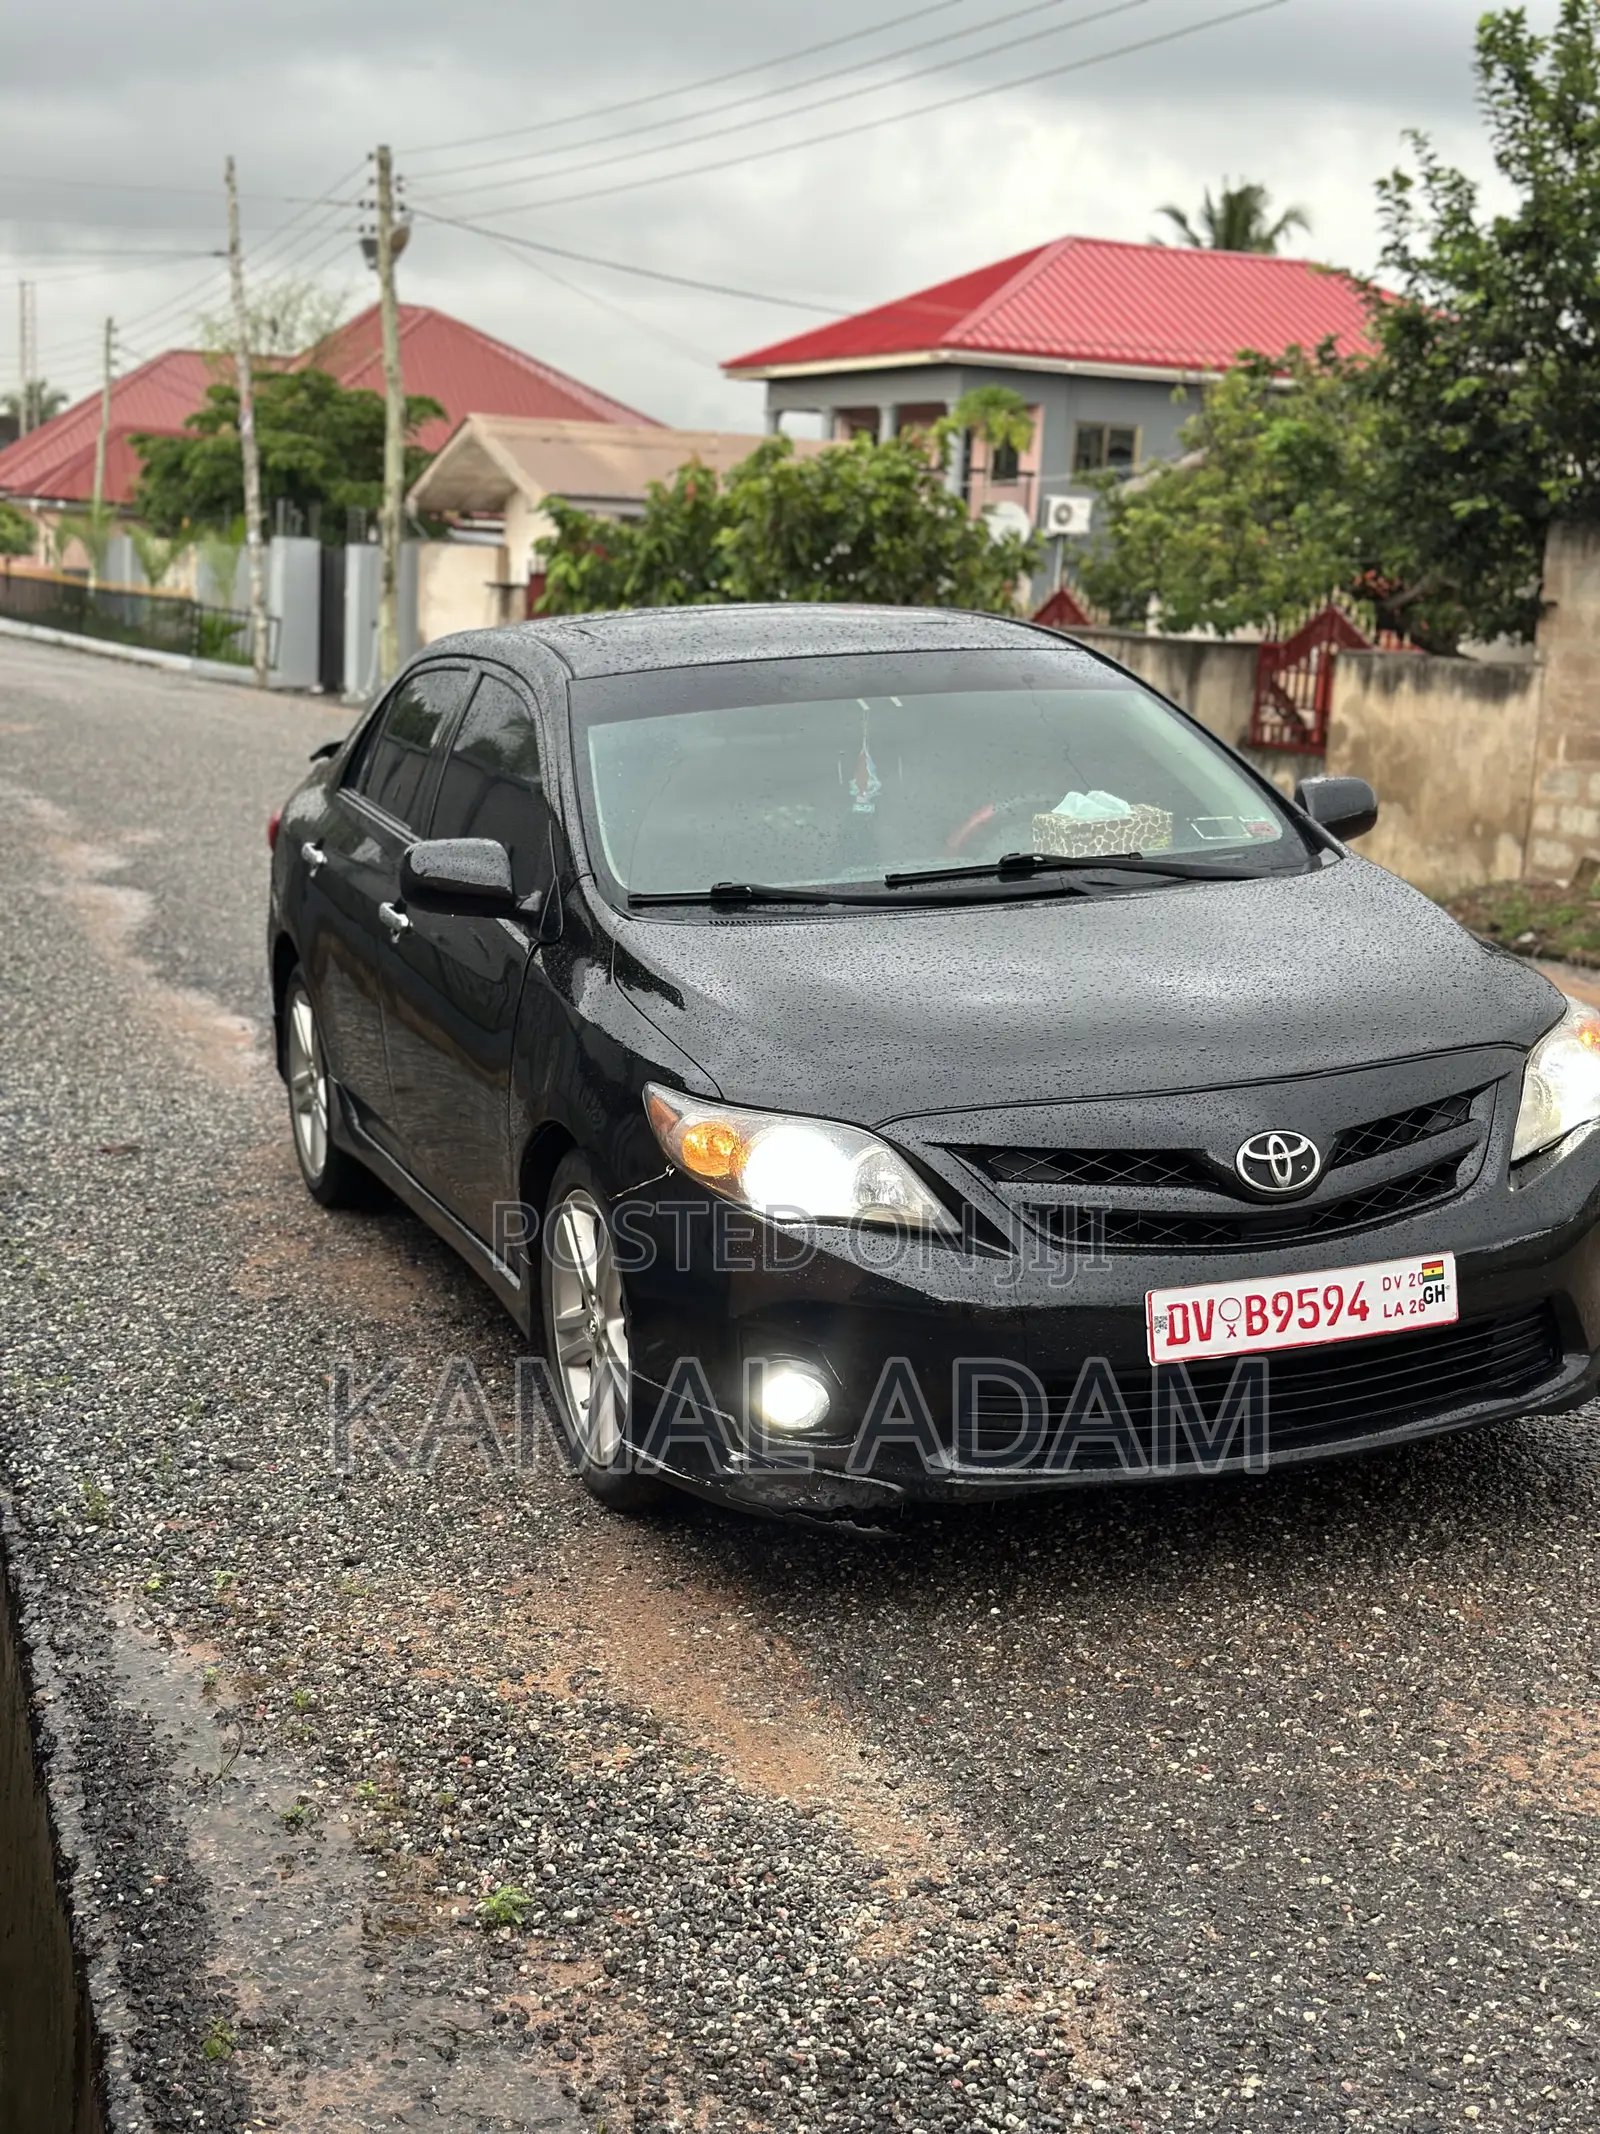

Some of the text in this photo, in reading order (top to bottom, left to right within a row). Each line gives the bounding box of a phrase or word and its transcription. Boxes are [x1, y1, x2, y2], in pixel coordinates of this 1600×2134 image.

[1382, 1272, 1424, 1291] DV 20
[1423, 1284, 1446, 1305] GH
[1166, 1281, 1370, 1347] DV B9594
[1384, 1299, 1426, 1318] LA 26
